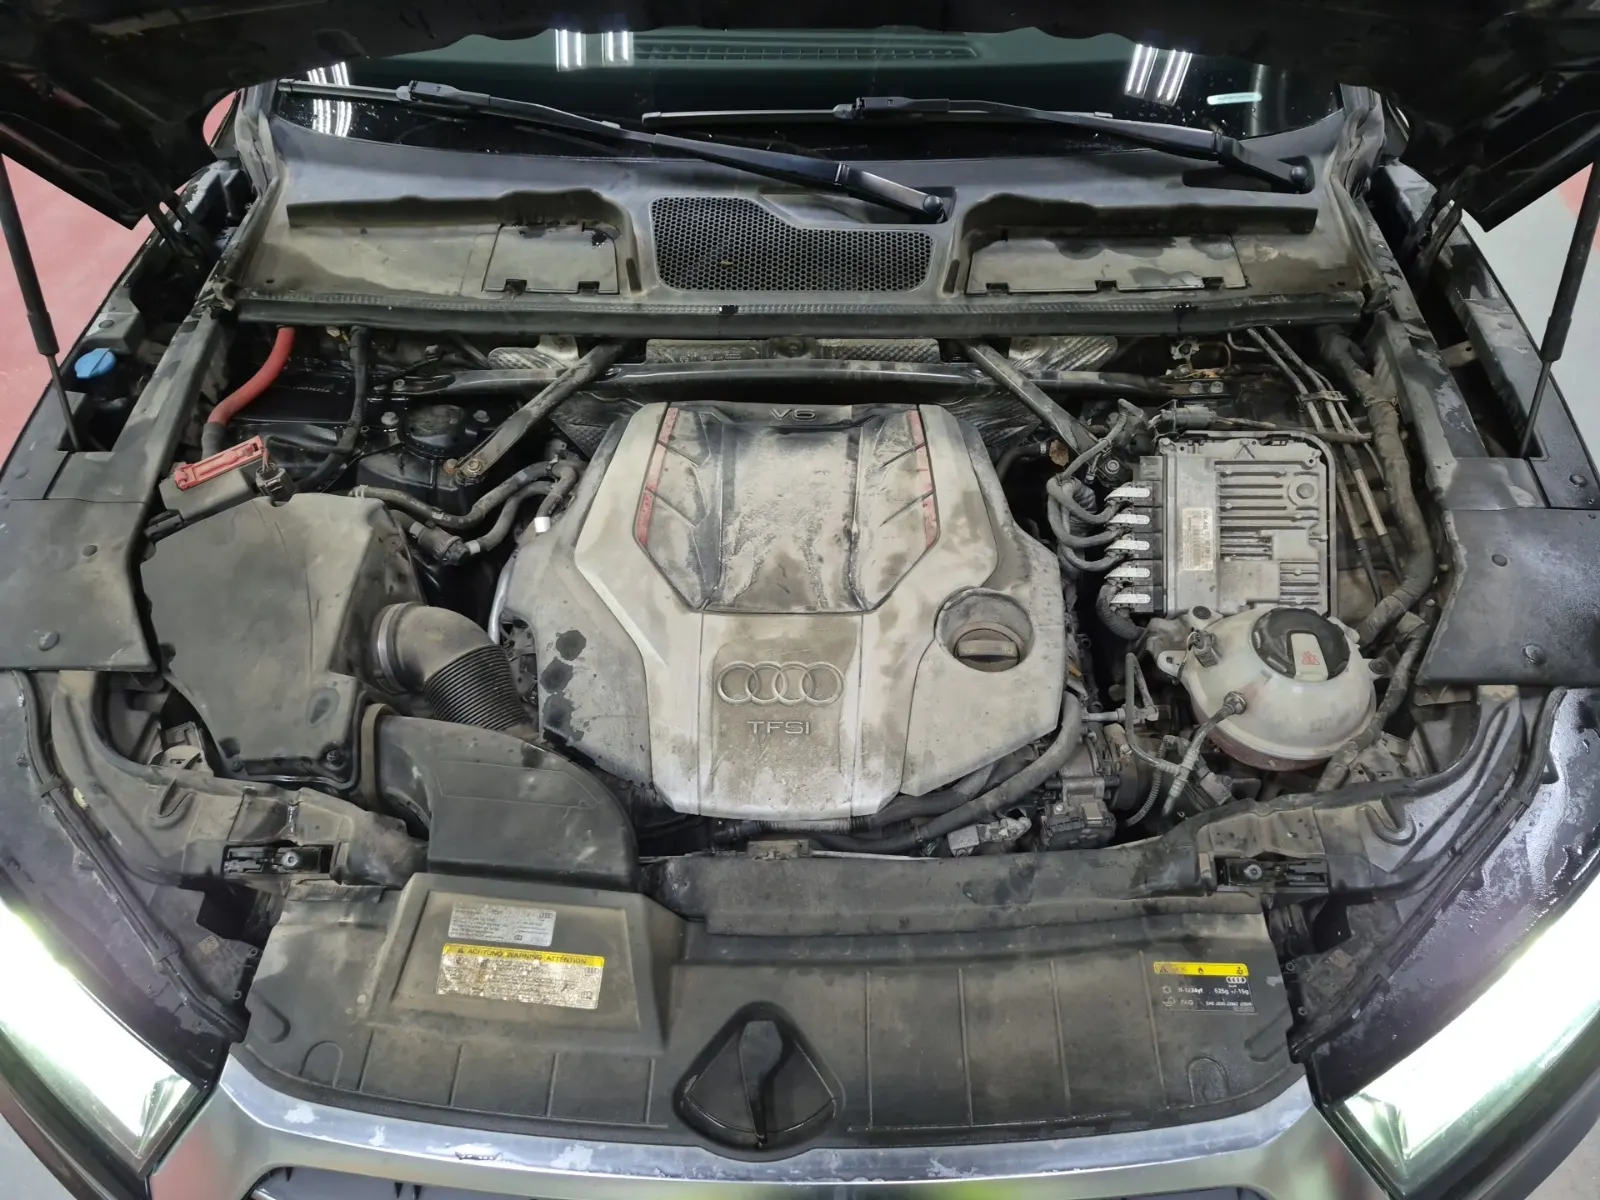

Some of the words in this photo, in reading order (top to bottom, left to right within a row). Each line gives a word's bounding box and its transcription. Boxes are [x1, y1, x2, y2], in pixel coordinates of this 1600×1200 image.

[769, 407, 816, 421] V6
[747, 721, 810, 734] TFSI
[467, 948, 503, 958] ACHTUNG
[506, 951, 542, 961] WARNING
[546, 955, 587, 965] ATTENTION
